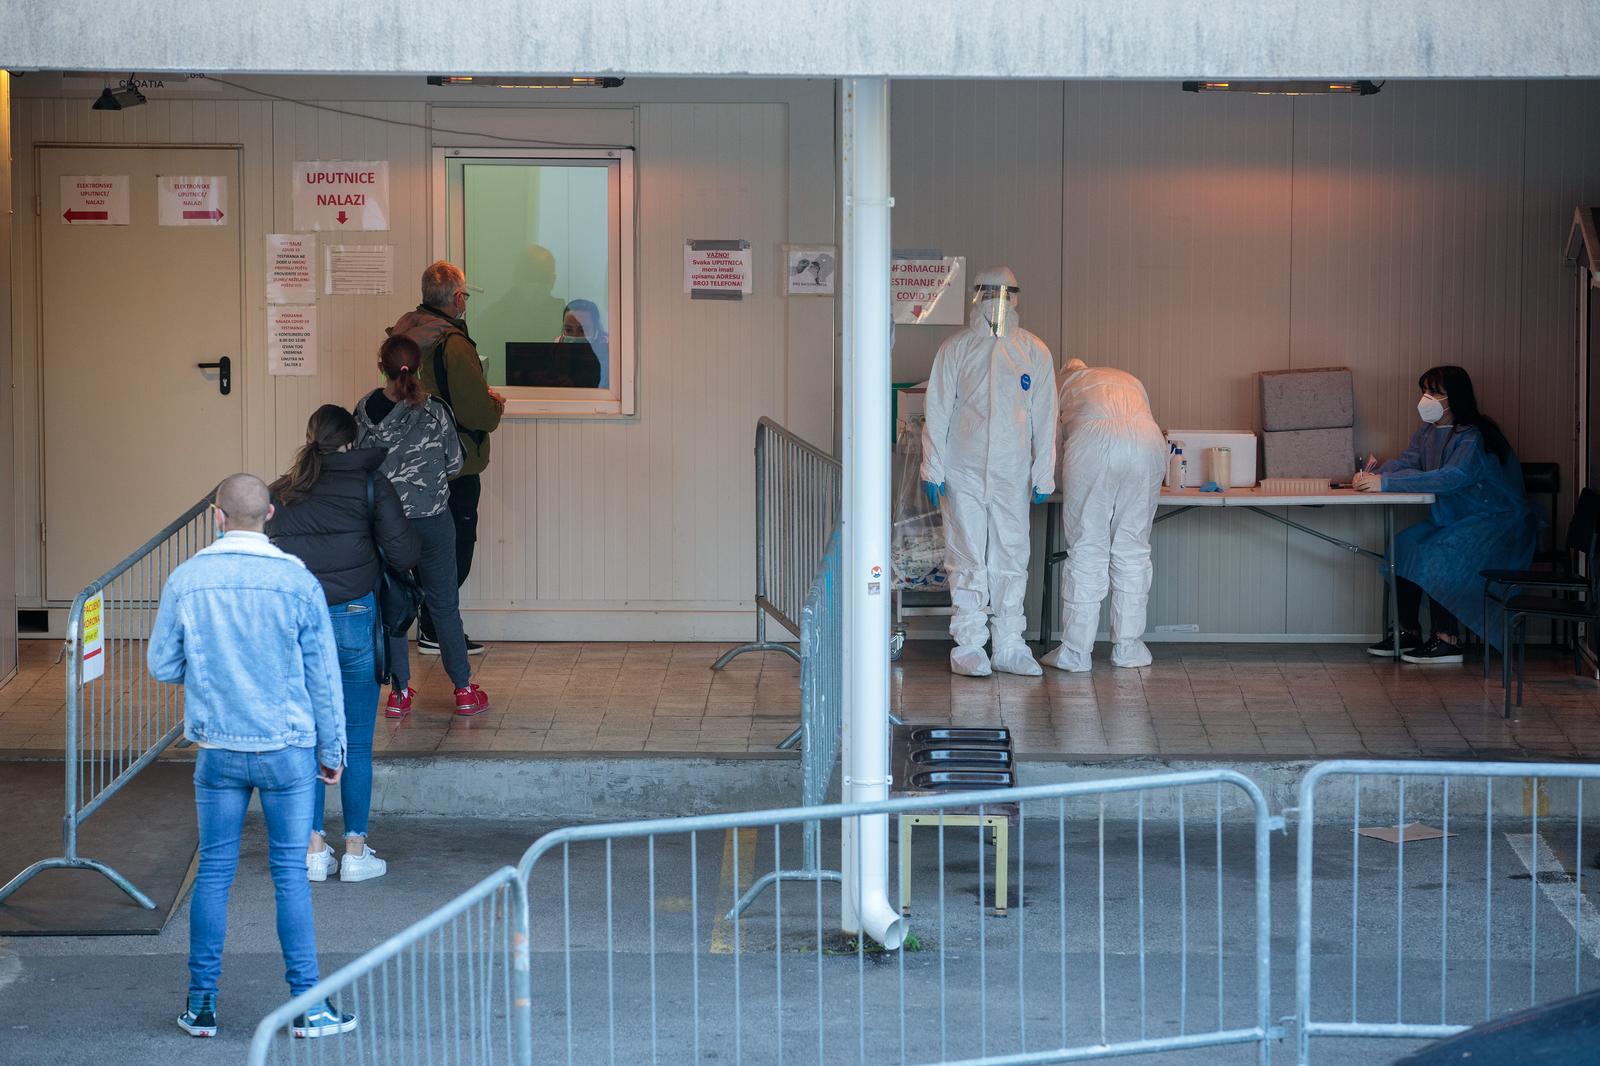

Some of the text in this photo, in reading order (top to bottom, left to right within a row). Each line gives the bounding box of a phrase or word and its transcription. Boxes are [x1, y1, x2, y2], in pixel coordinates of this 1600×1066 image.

[306, 172, 376, 184] UPUTNICE
[316, 194, 366, 206] NALAZI
[706, 250, 730, 258] VAŽNO!
[891, 278, 936, 287] ESTIRANJE
[896, 291, 925, 301] COVID
